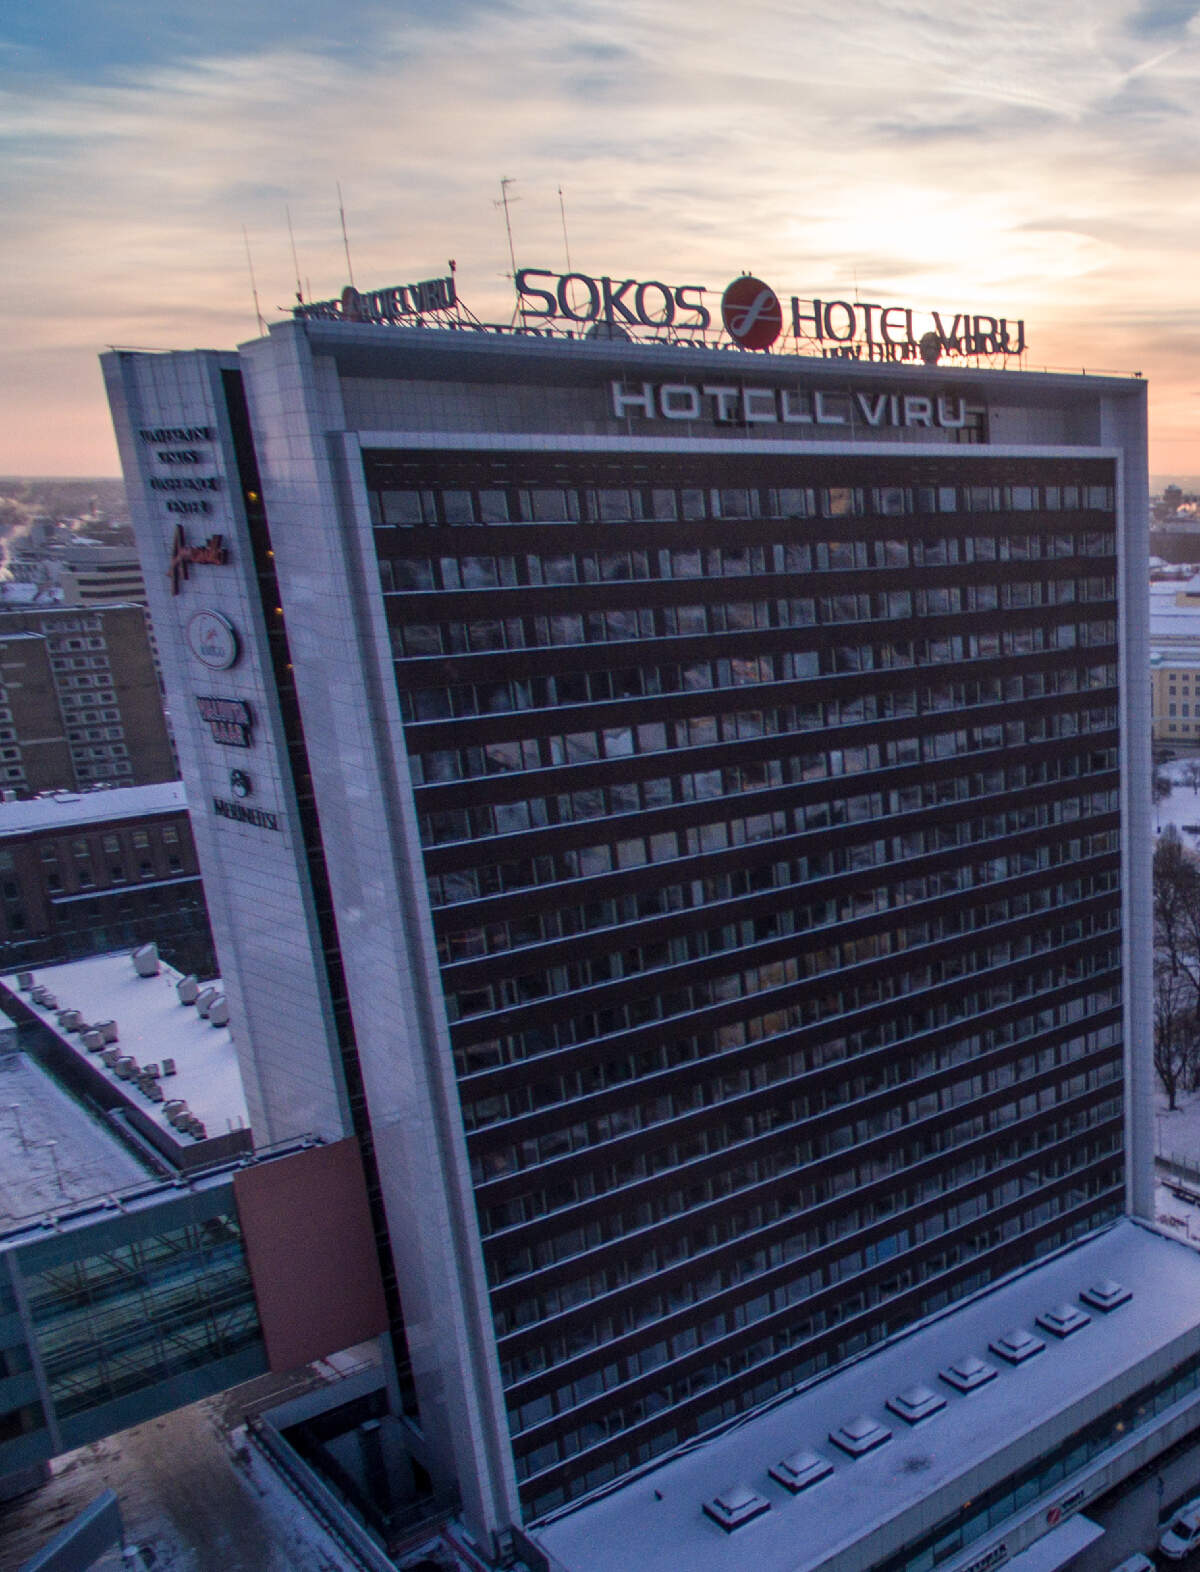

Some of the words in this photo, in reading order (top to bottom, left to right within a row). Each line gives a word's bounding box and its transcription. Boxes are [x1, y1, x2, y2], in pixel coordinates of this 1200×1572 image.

[515, 268, 711, 331] SOKOS
[791, 296, 921, 347] HOTEL
[930, 311, 1026, 355] VIRU
[857, 392, 967, 428] VIRU
